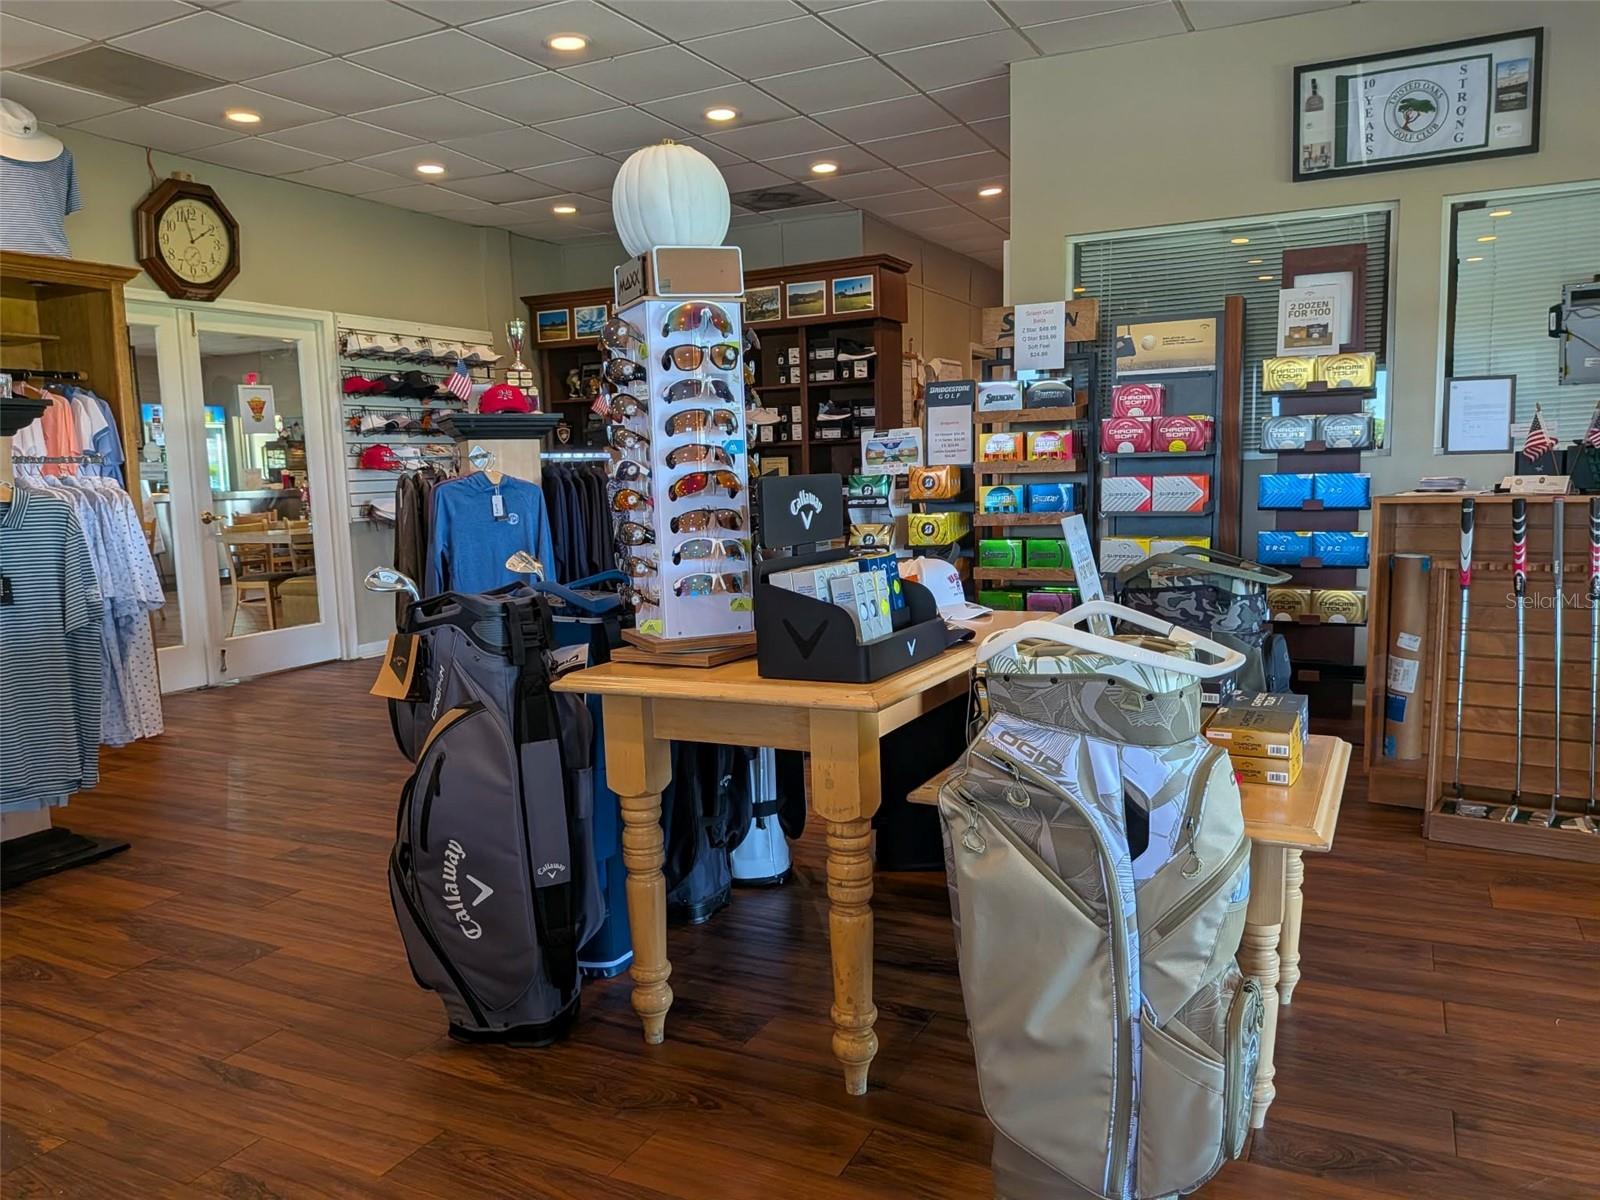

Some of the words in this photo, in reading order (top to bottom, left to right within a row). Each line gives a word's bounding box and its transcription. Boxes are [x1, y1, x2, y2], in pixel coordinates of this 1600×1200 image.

[1364, 79, 1376, 90] 10
[1388, 82, 1421, 105] TWISTED
[1422, 82, 1444, 100] OAKS
[1454, 64, 1468, 144] STRONG
[1364, 96, 1375, 156] YEARS
[1394, 128, 1414, 142] GOLF
[1416, 123, 1439, 140] CLUB
[620, 268, 640, 293] MAXX
[1288, 310, 1308, 318] FOR
[1310, 308, 1331, 316] $100
[1298, 301, 1329, 310] DOZEN
[929, 385, 970, 394] BRIDGESTONE
[790, 490, 822, 515] Callaway
[998, 730, 1063, 775] OGIO
[537, 864, 566, 876] Callaway
[442, 840, 482, 940] Callaway
